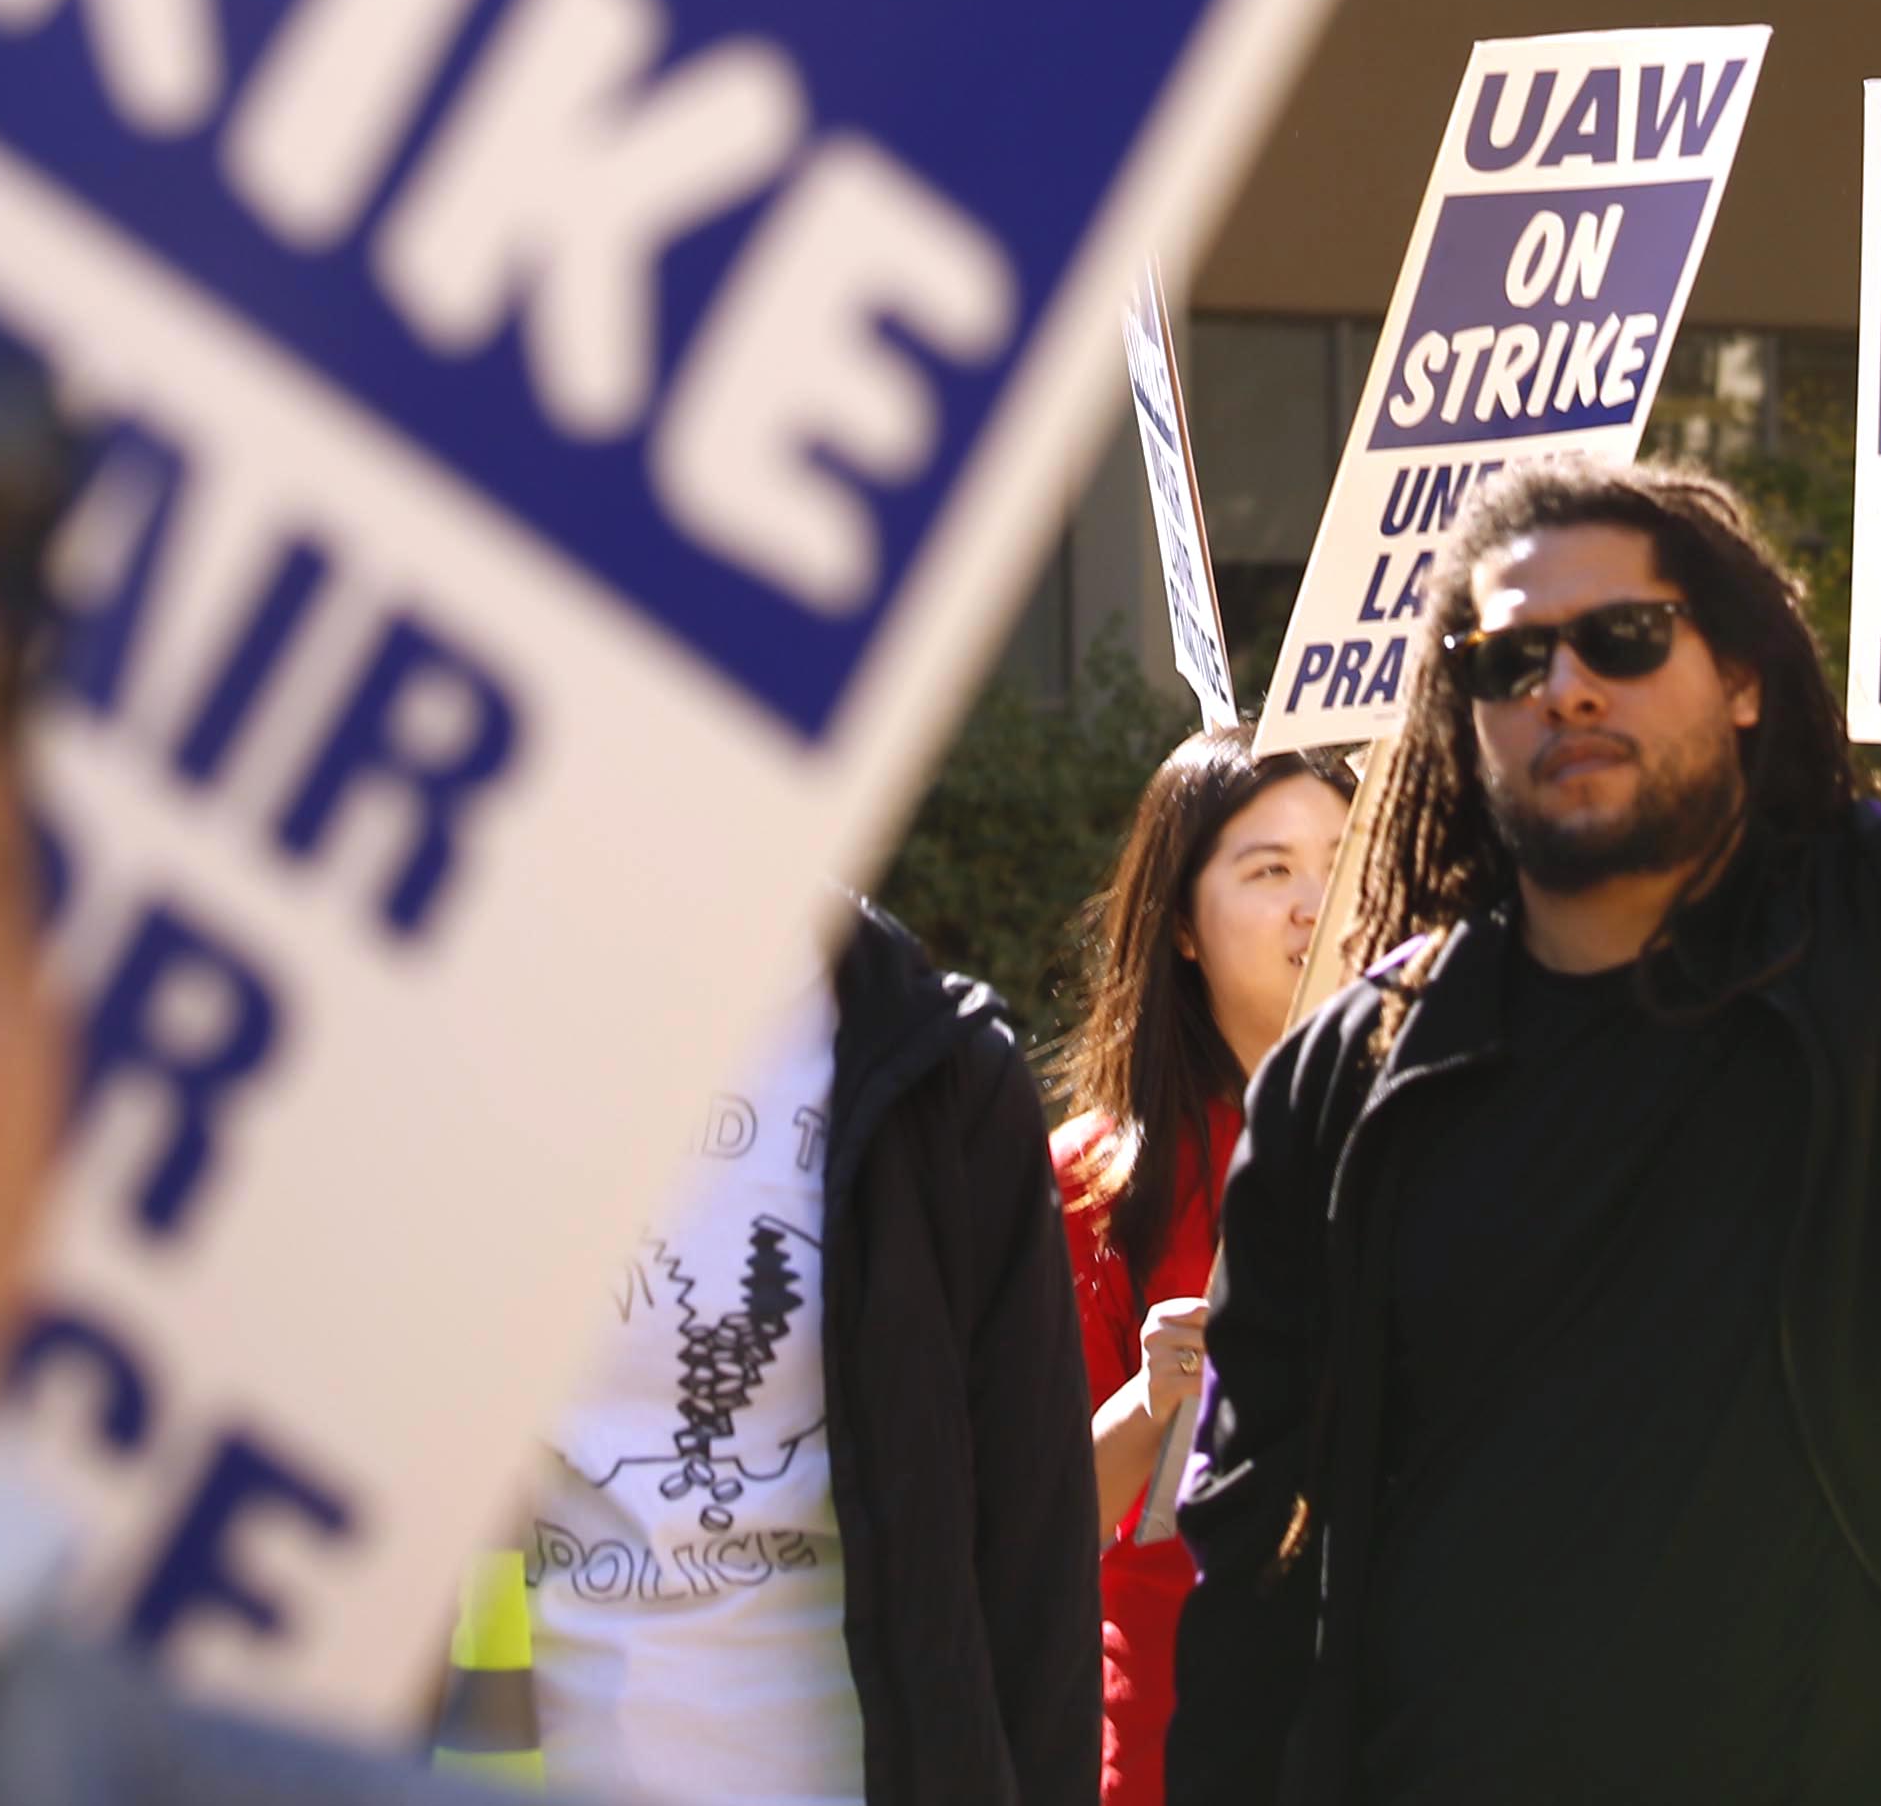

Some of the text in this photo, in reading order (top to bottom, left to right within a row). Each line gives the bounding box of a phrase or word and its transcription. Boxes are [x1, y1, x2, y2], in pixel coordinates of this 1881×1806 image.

[1464, 59, 1747, 171] UAW
[1506, 204, 1624, 308] ON
[1388, 314, 1657, 429] STRIKE
[524, 1520, 818, 1604] POLICE
